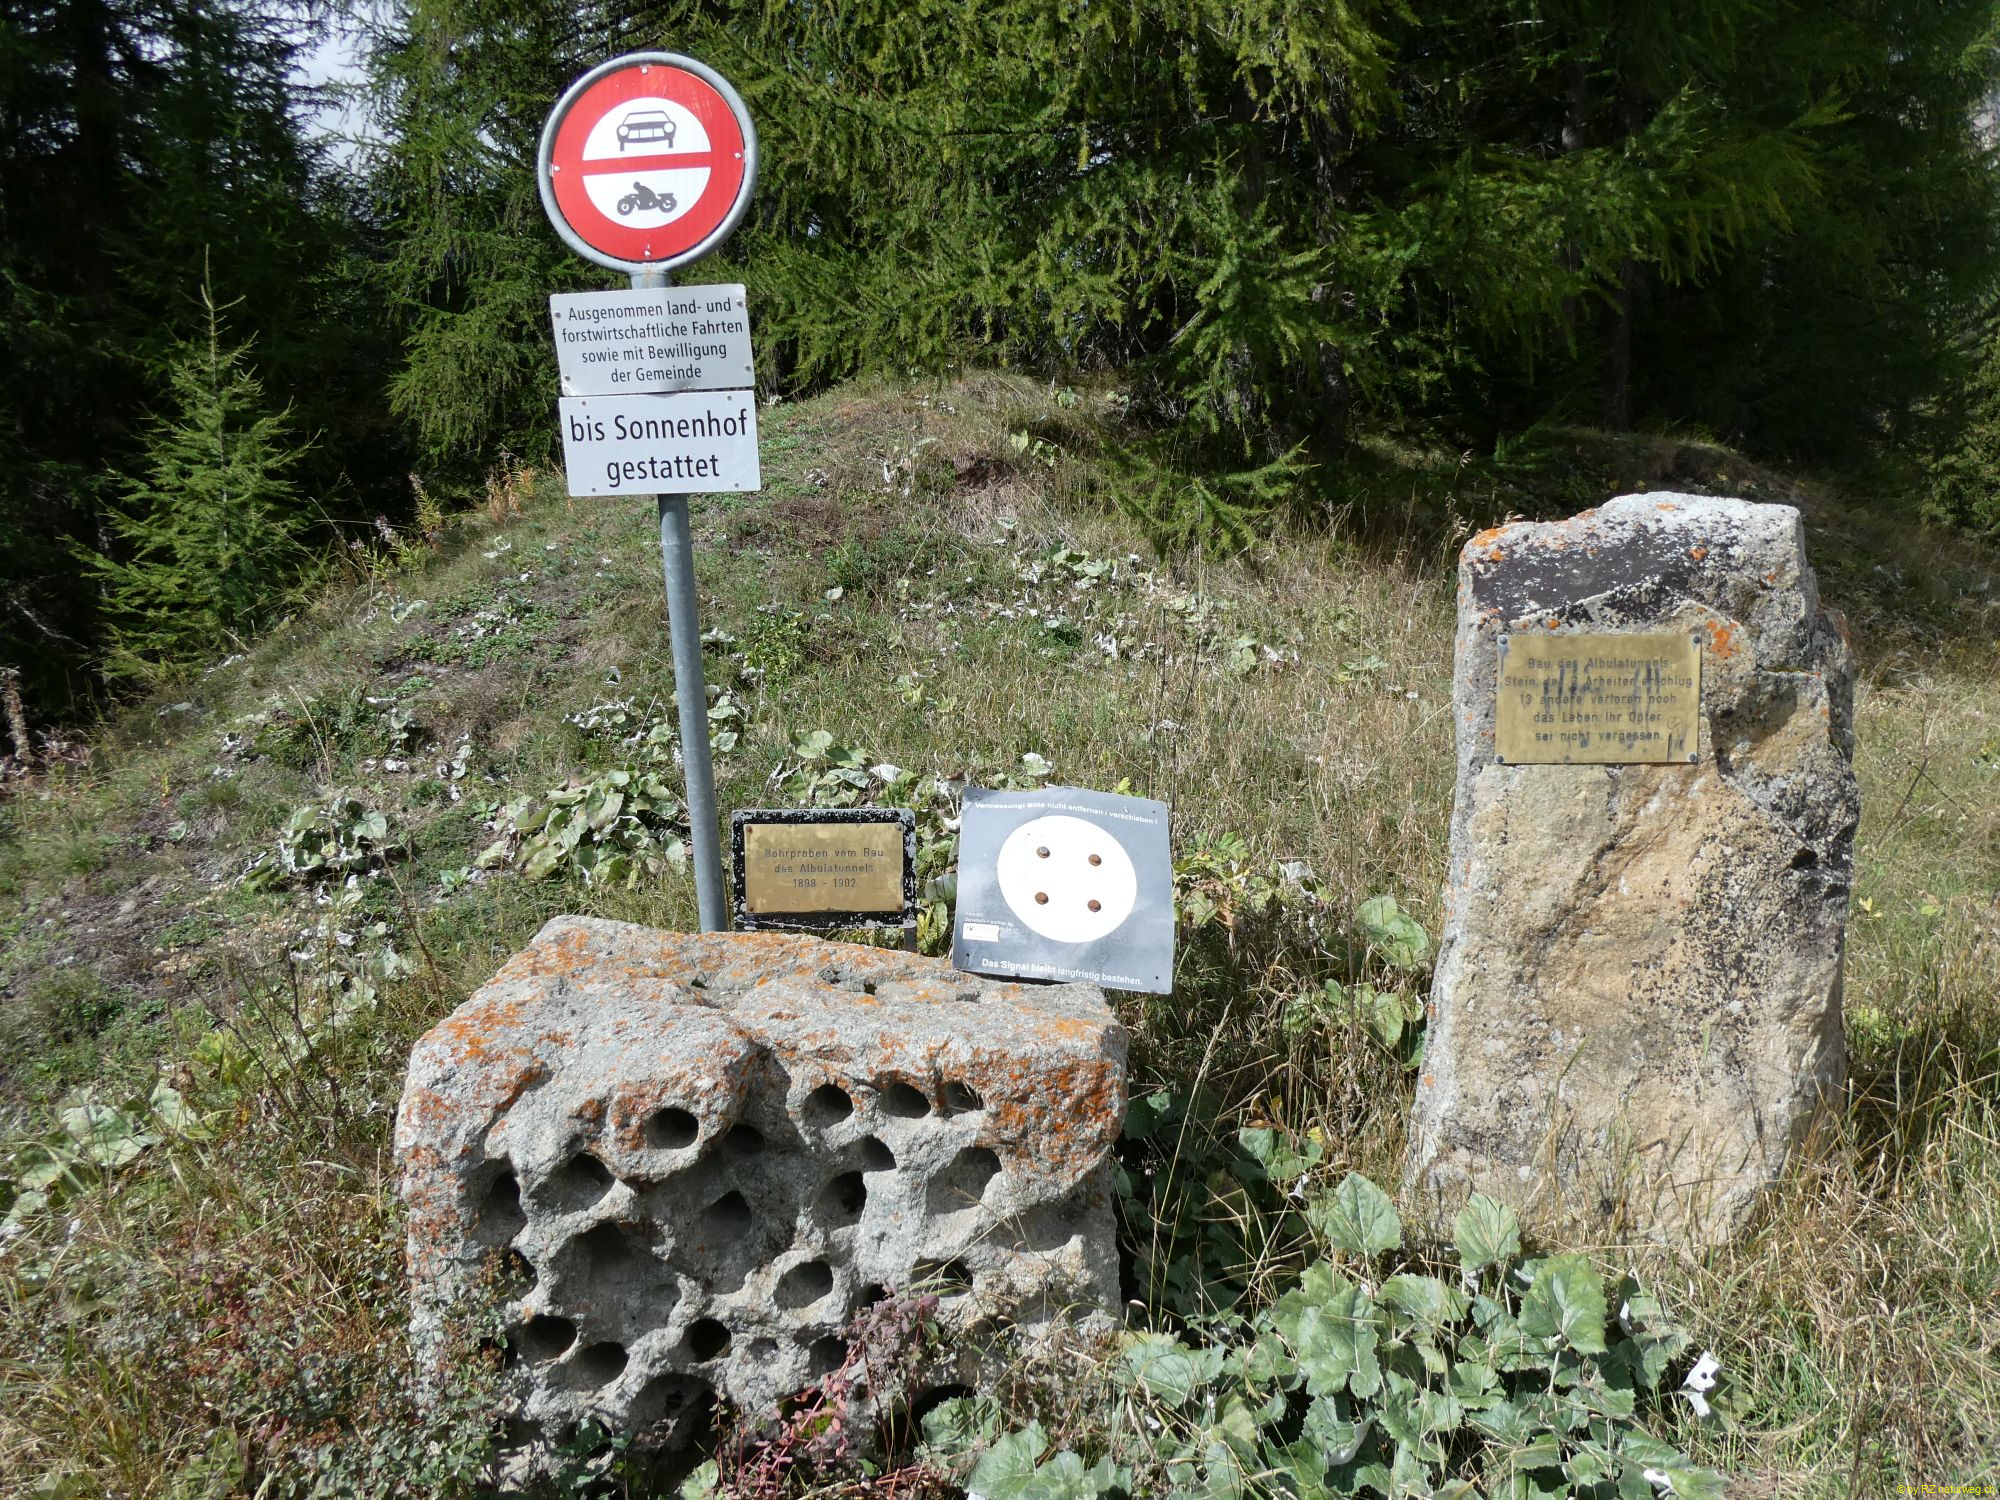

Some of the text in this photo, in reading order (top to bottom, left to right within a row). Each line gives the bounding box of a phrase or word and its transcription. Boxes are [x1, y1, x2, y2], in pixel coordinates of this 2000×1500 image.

[568, 297, 731, 323] Ausgenommen land- und
[562, 320, 743, 343] forstwirtschaftliche Fahrten
[582, 343, 727, 363] sowie mit Bewilligung
[611, 364, 702, 382] der Gemeinde
[570, 408, 747, 442] bis Sonnenhof
[607, 454, 720, 488] gestattet
[1528, 658, 1551, 668] Bau
[1557, 658, 1578, 669] des
[1641, 676, 1692, 688] erschlug
[1520, 694, 1532, 705] 13
[1540, 695, 1582, 705] andere
[1648, 694, 1676, 704] noch
[1534, 712, 1554, 723] das
[1605, 712, 1622, 722] Ihr
[1629, 712, 1662, 724] Opfer
[1535, 730, 1663, 743] sei nicht vergessen.
[1047, 802, 1067, 810] nicht
[1068, 804, 1104, 816] entfernen
[1109, 811, 1154, 824] verschieben
[764, 848, 884, 860] Bohrproben vom Bau
[774, 863, 874, 873] des Albulatunnels
[793, 878, 817, 888] 1898
[834, 878, 857, 888] 1902
[982, 958, 1143, 985] Das Signal bleibt langfristig bestehen.
